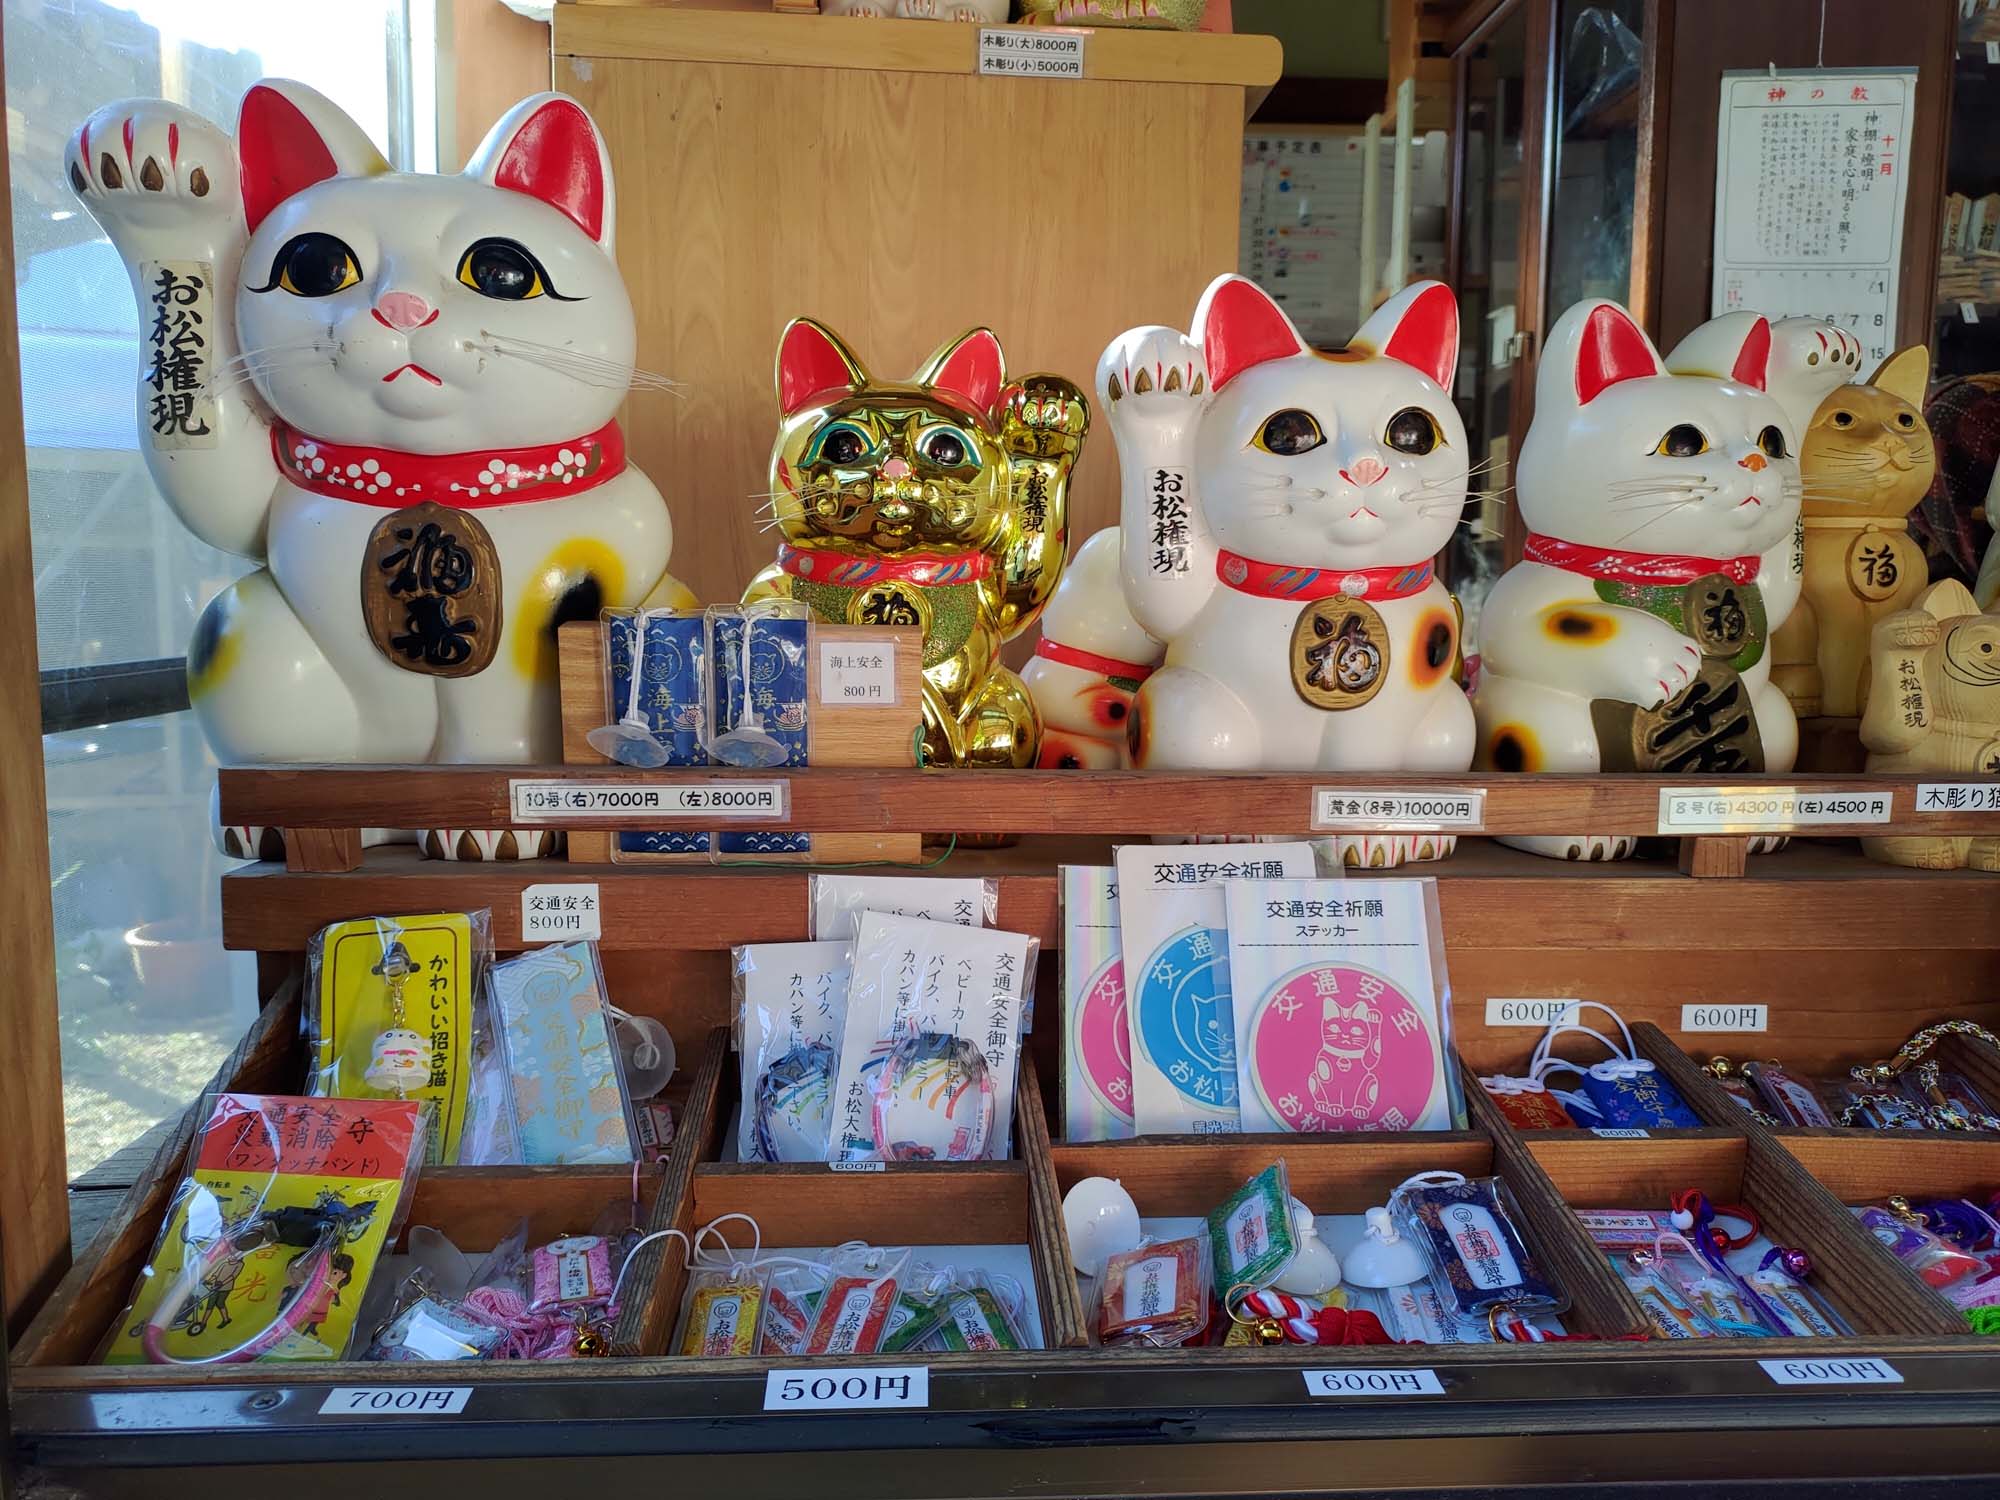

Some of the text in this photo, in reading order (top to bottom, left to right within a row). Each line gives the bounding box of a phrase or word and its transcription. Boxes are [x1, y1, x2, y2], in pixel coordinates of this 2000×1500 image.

[983, 35, 1077, 52] 木彫り(大)8000円
[984, 58, 1079, 73] 木彫り(小)5000円
[1879, 134, 1896, 176] 十一月
[1850, 315, 1860, 326] 7
[1873, 315, 1884, 327] 8
[146, 268, 210, 436] お松権現
[1022, 468, 1050, 534] お松権現
[1151, 469, 1190, 574] お松権現
[1858, 543, 1899, 588] 福
[829, 655, 883, 670] 海上安全
[1305, 613, 1382, 692] 福
[1898, 658, 1929, 730] お松権現
[528, 896, 595, 911] 交通安全
[1266, 898, 1384, 919] 交通安全祈願
[529, 914, 581, 930] 800円
[1295, 924, 1360, 938] ステッカー
[985, 952, 1016, 1068] 交通安全御守
[1271, 968, 1420, 1038] 交通安全
[1500, 1002, 1567, 1022] 600円
[427, 954, 449, 1089] かわいい招き猫
[1693, 1007, 1758, 1028] 600円
[346, 1116, 375, 1145] 守
[1783, 1361, 1887, 1379] 600円
[781, 1375, 912, 1401] 500円
[1322, 1373, 1422, 1391] 600円
[348, 1389, 456, 1410] 700円
